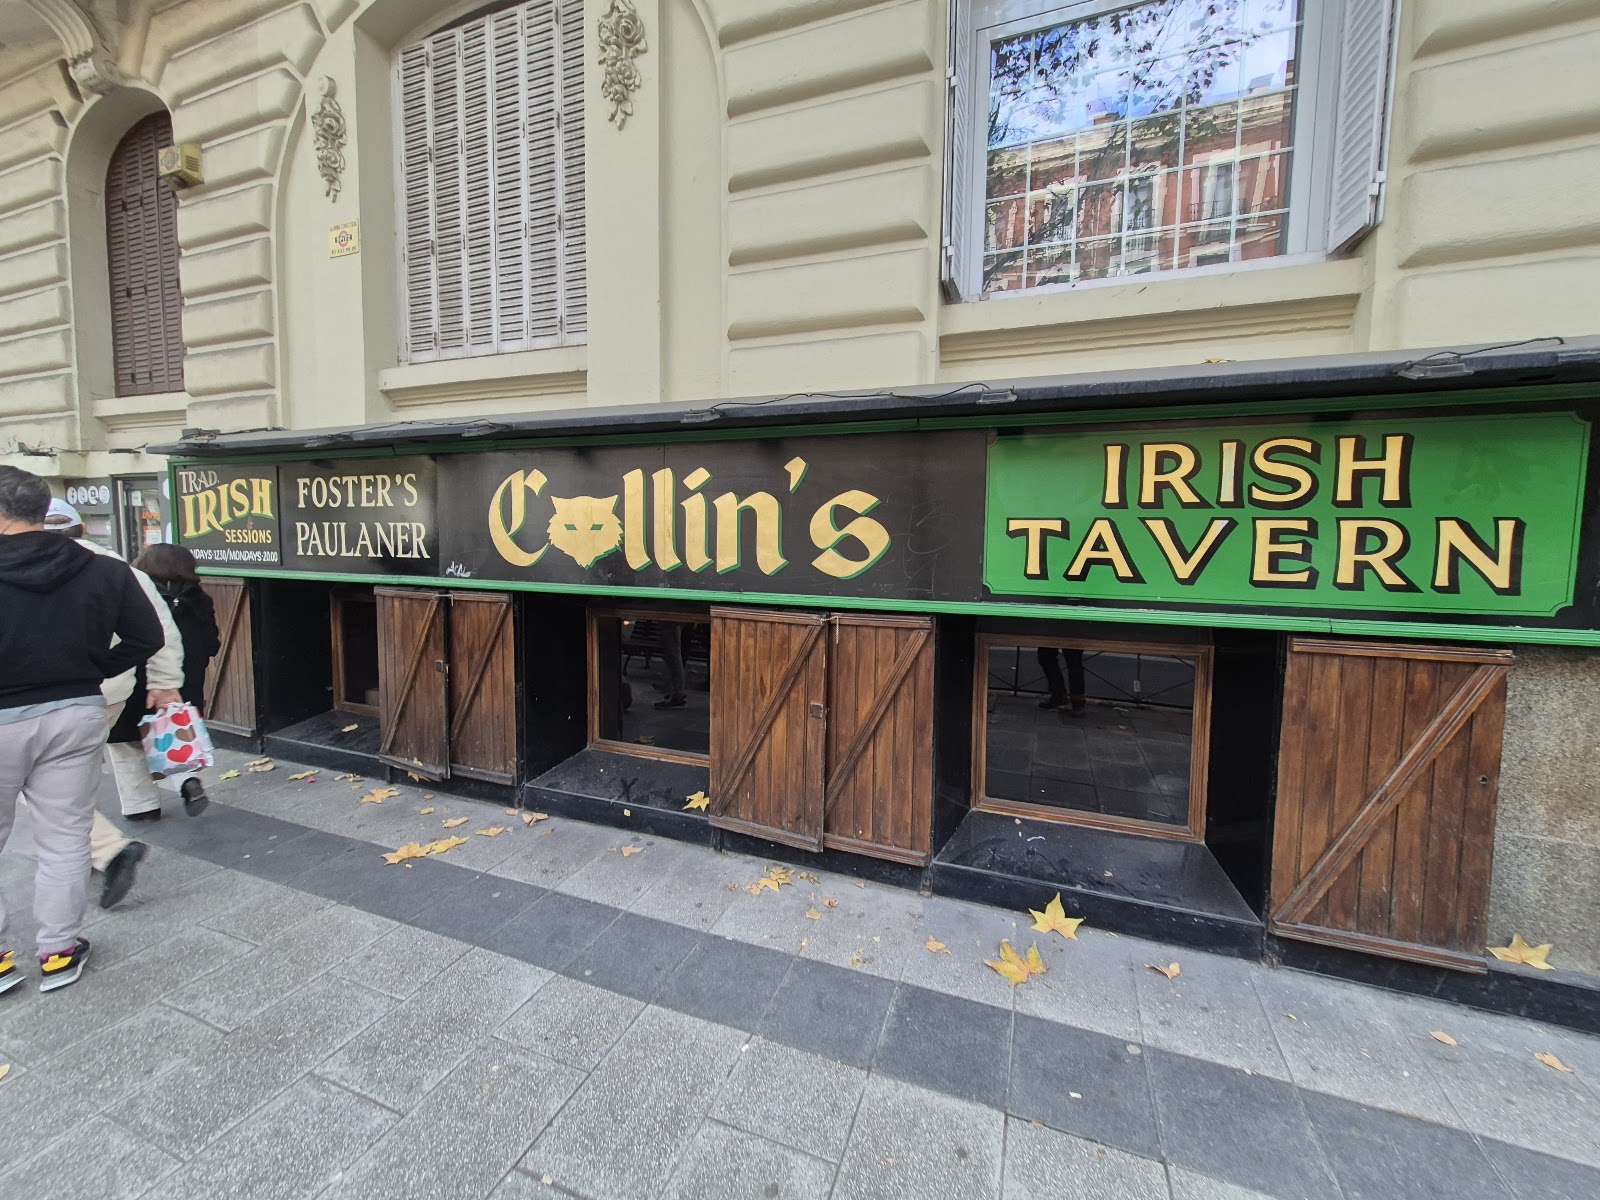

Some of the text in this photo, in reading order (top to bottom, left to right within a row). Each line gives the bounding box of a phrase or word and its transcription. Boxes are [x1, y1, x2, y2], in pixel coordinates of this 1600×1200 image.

[179, 470, 219, 493] TRAD.
[297, 473, 418, 509] FOSTER'S
[1102, 433, 1412, 509] IRISH
[181, 478, 275, 538] IRISH
[488, 456, 891, 579] Cllin's
[225, 529, 272, 544] SESSIONS
[295, 521, 430, 559] PAULANER
[1006, 517, 1525, 595] TAVERN
